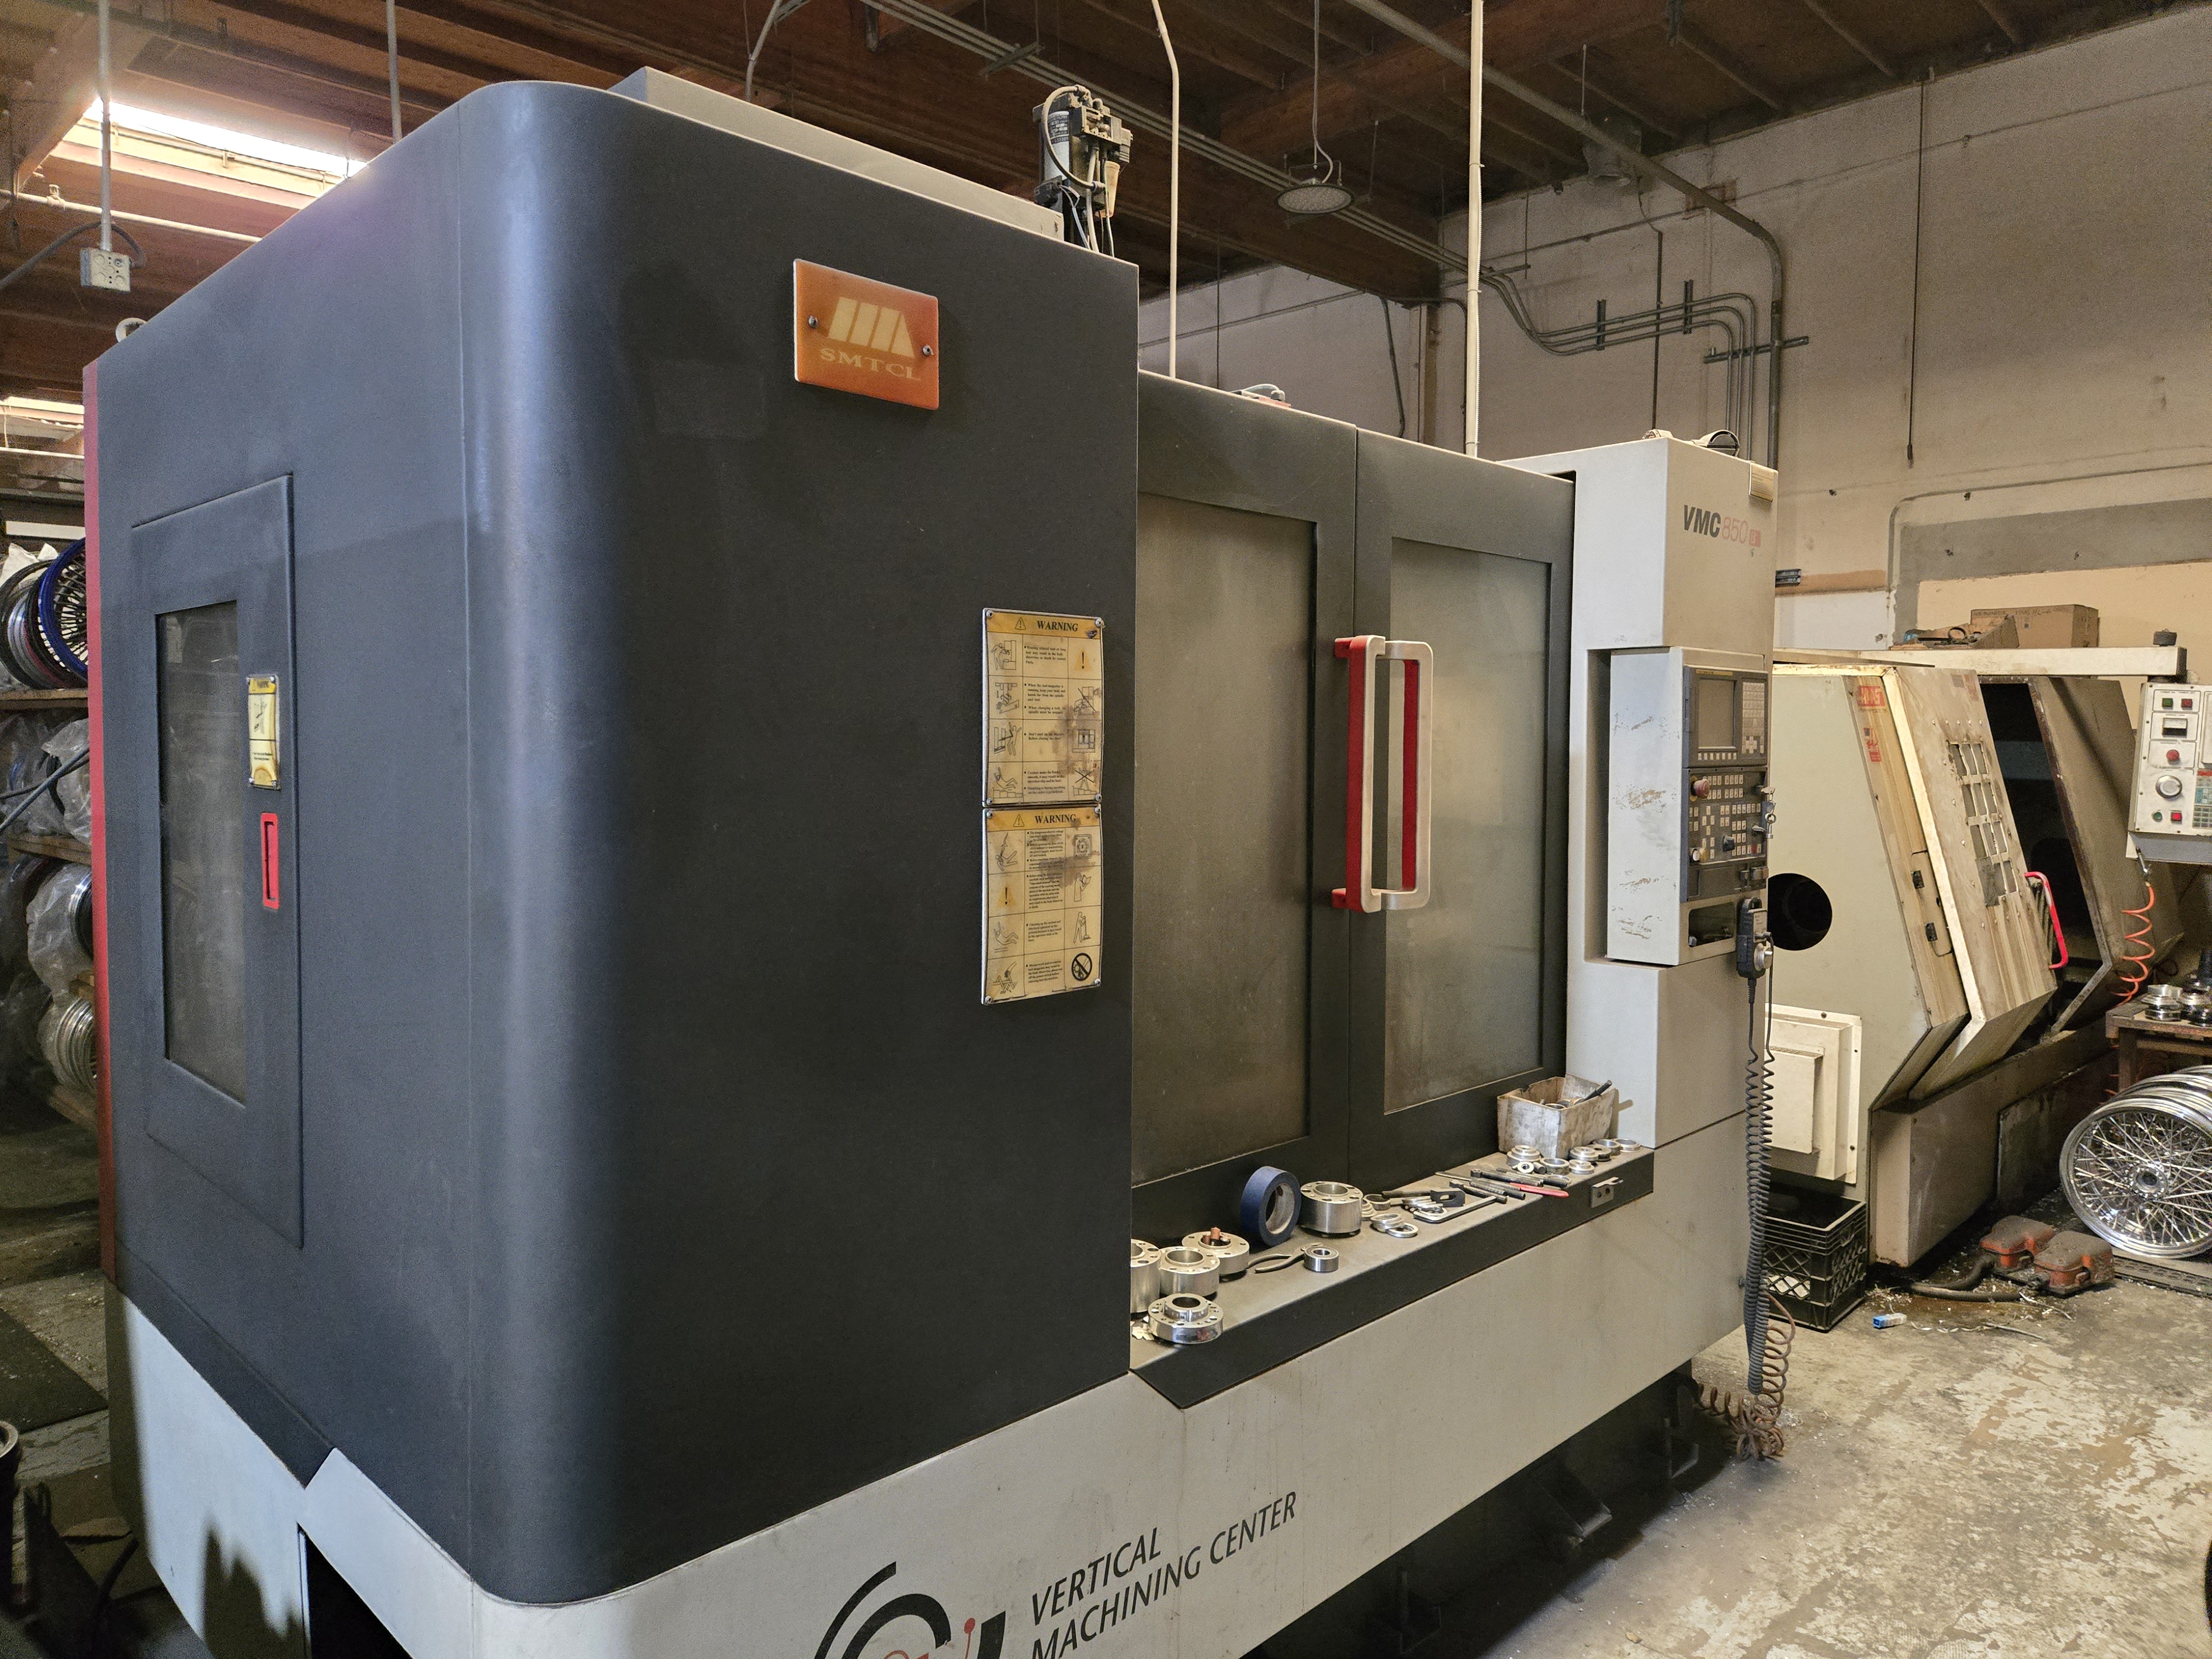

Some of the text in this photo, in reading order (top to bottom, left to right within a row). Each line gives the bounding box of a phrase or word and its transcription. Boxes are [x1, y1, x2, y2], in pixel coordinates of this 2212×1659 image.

[820, 347, 921, 381] SMTCL
[1037, 620, 1078, 632] WARNING
[1035, 814, 1076, 824] WARNING
[1032, 1491, 1296, 1659] MACHINING CENTER
[1032, 1527, 1161, 1626] VERTICAL
